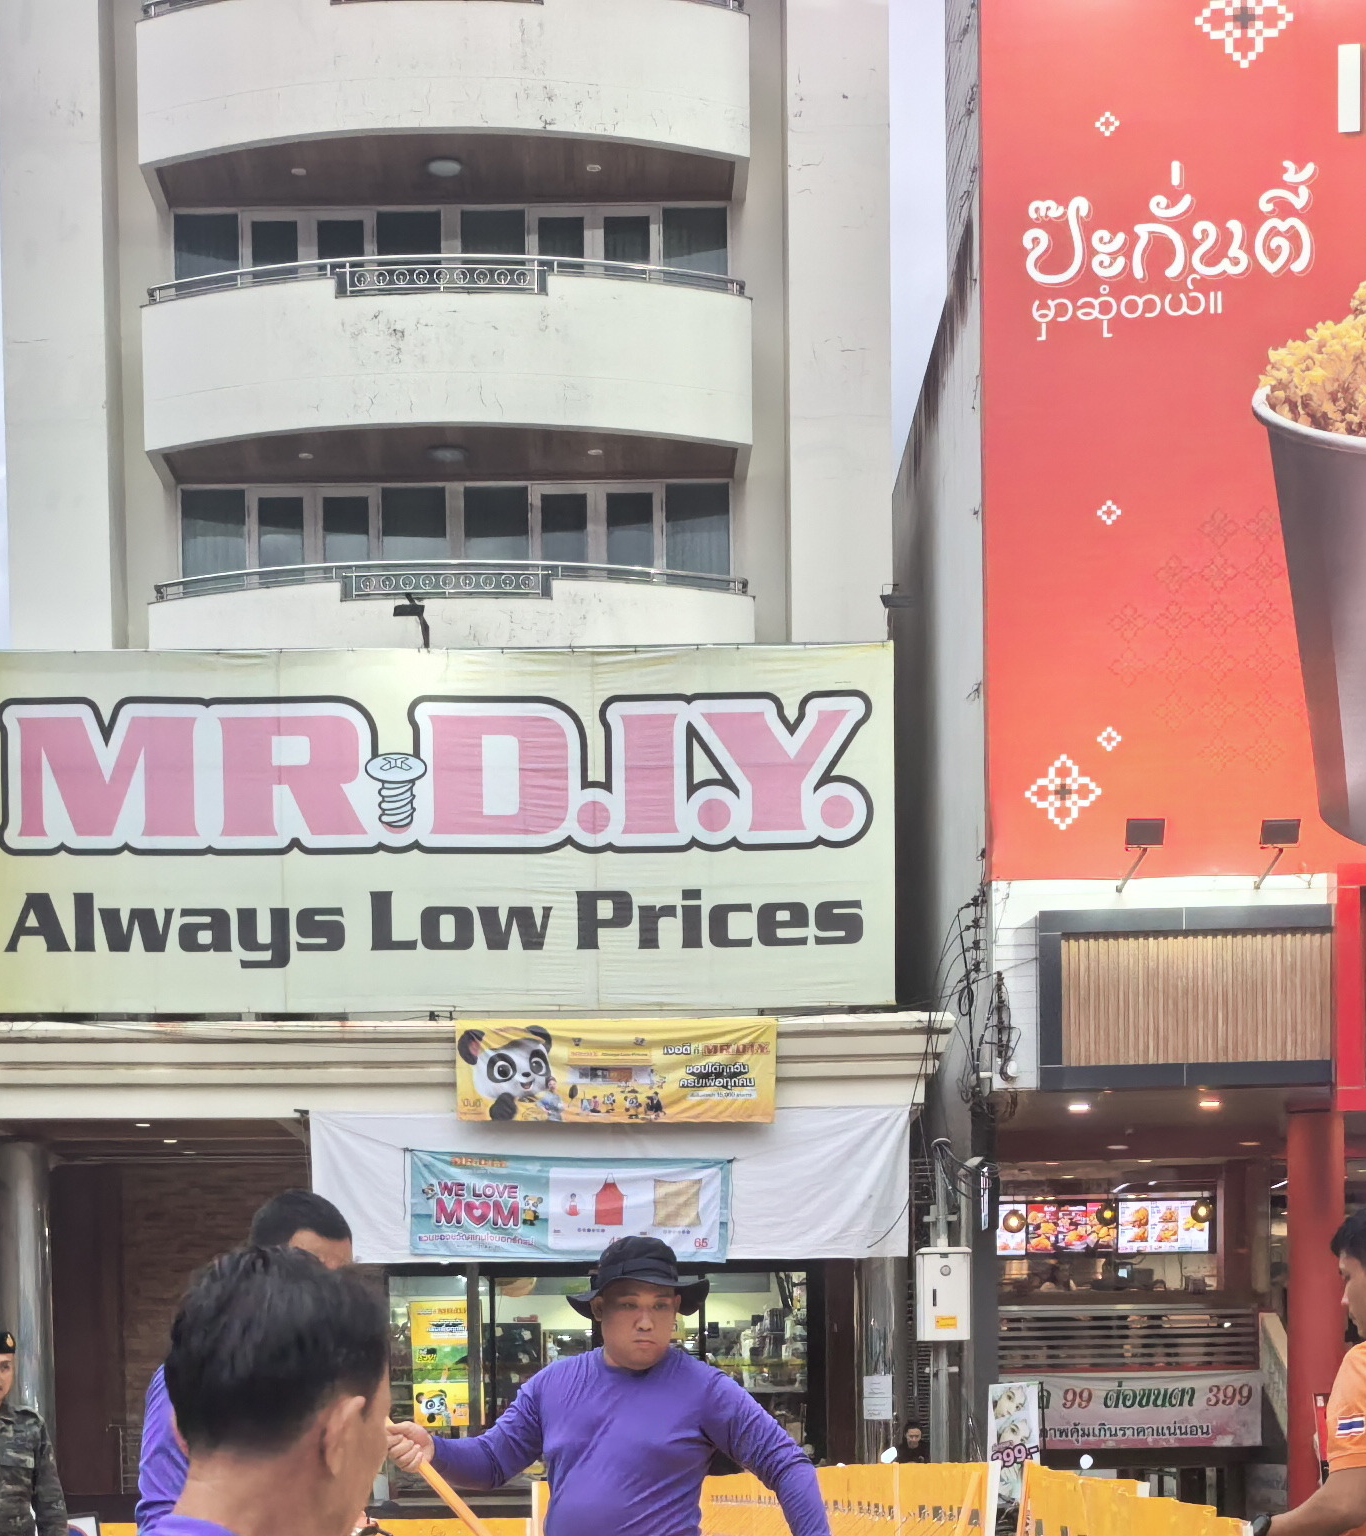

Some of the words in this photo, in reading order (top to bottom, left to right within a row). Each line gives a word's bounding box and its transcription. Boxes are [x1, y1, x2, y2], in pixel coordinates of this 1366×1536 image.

[5, 892, 344, 968] Always
[370, 890, 552, 952] Low
[575, 887, 864, 950] Prices
[437, 1181, 466, 1198] WE
[472, 1182, 519, 1199] LOVE
[1062, 1387, 1093, 1409] 99
[1206, 1383, 1253, 1406] 399
